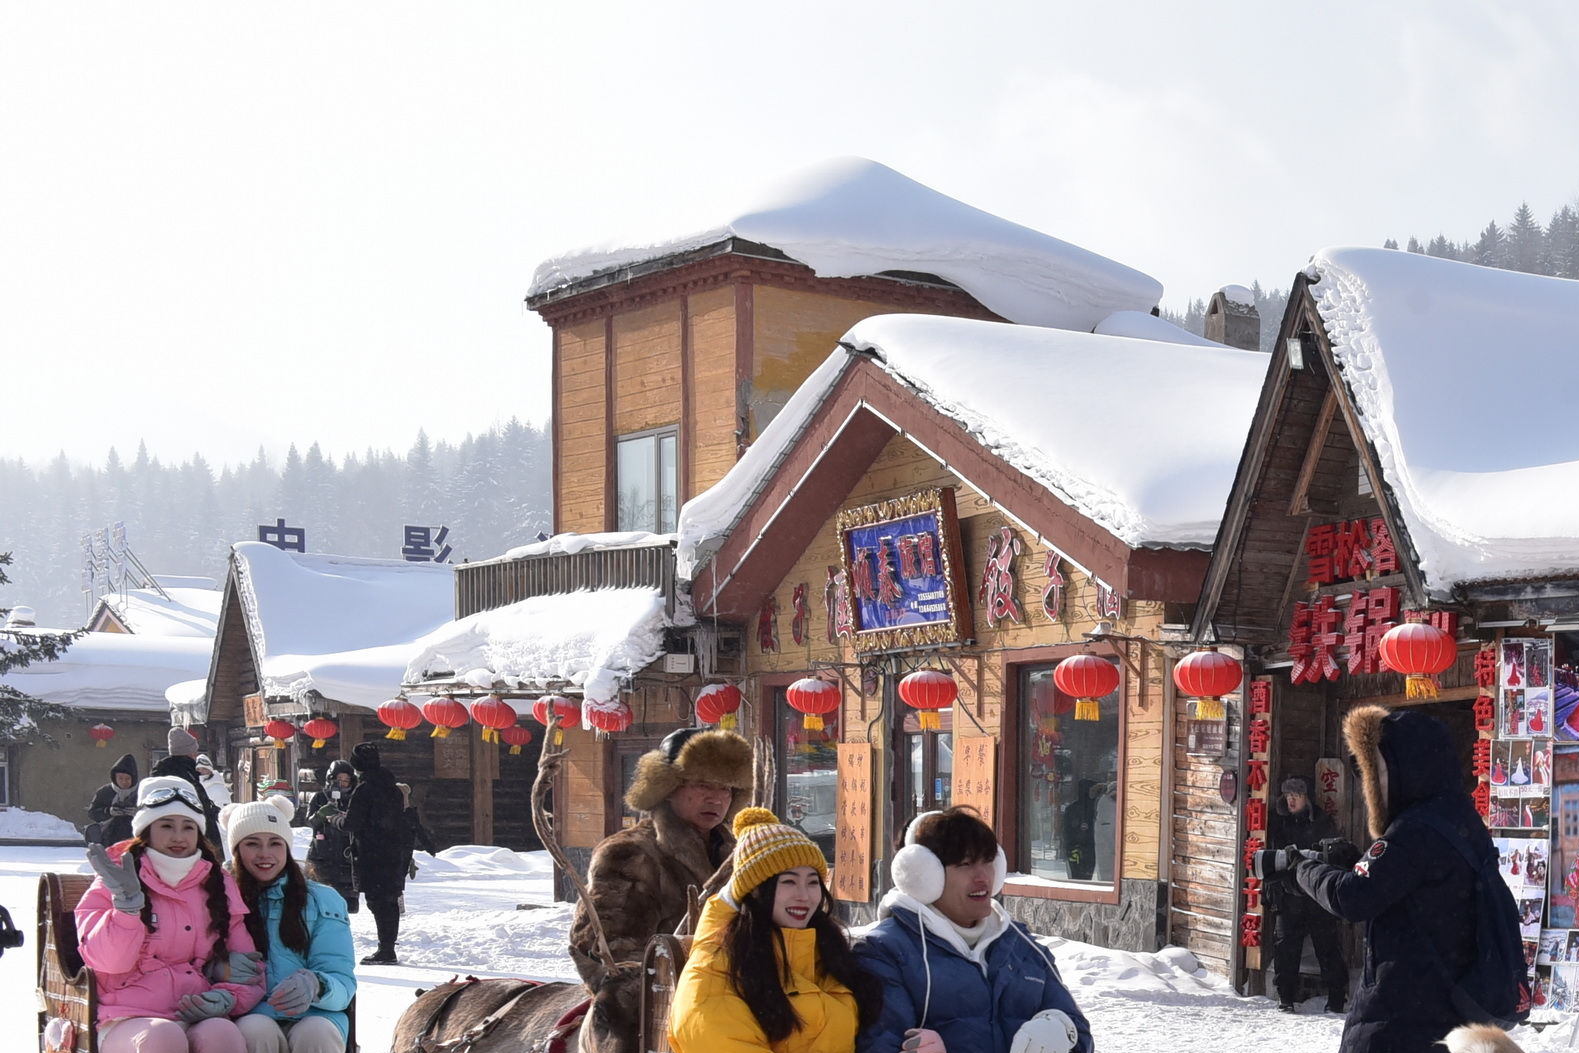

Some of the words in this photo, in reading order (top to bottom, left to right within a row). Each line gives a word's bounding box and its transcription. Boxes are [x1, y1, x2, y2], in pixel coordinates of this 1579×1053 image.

[1289, 586, 1457, 688] 铁锅
[1471, 648, 1496, 818] 特色美食
